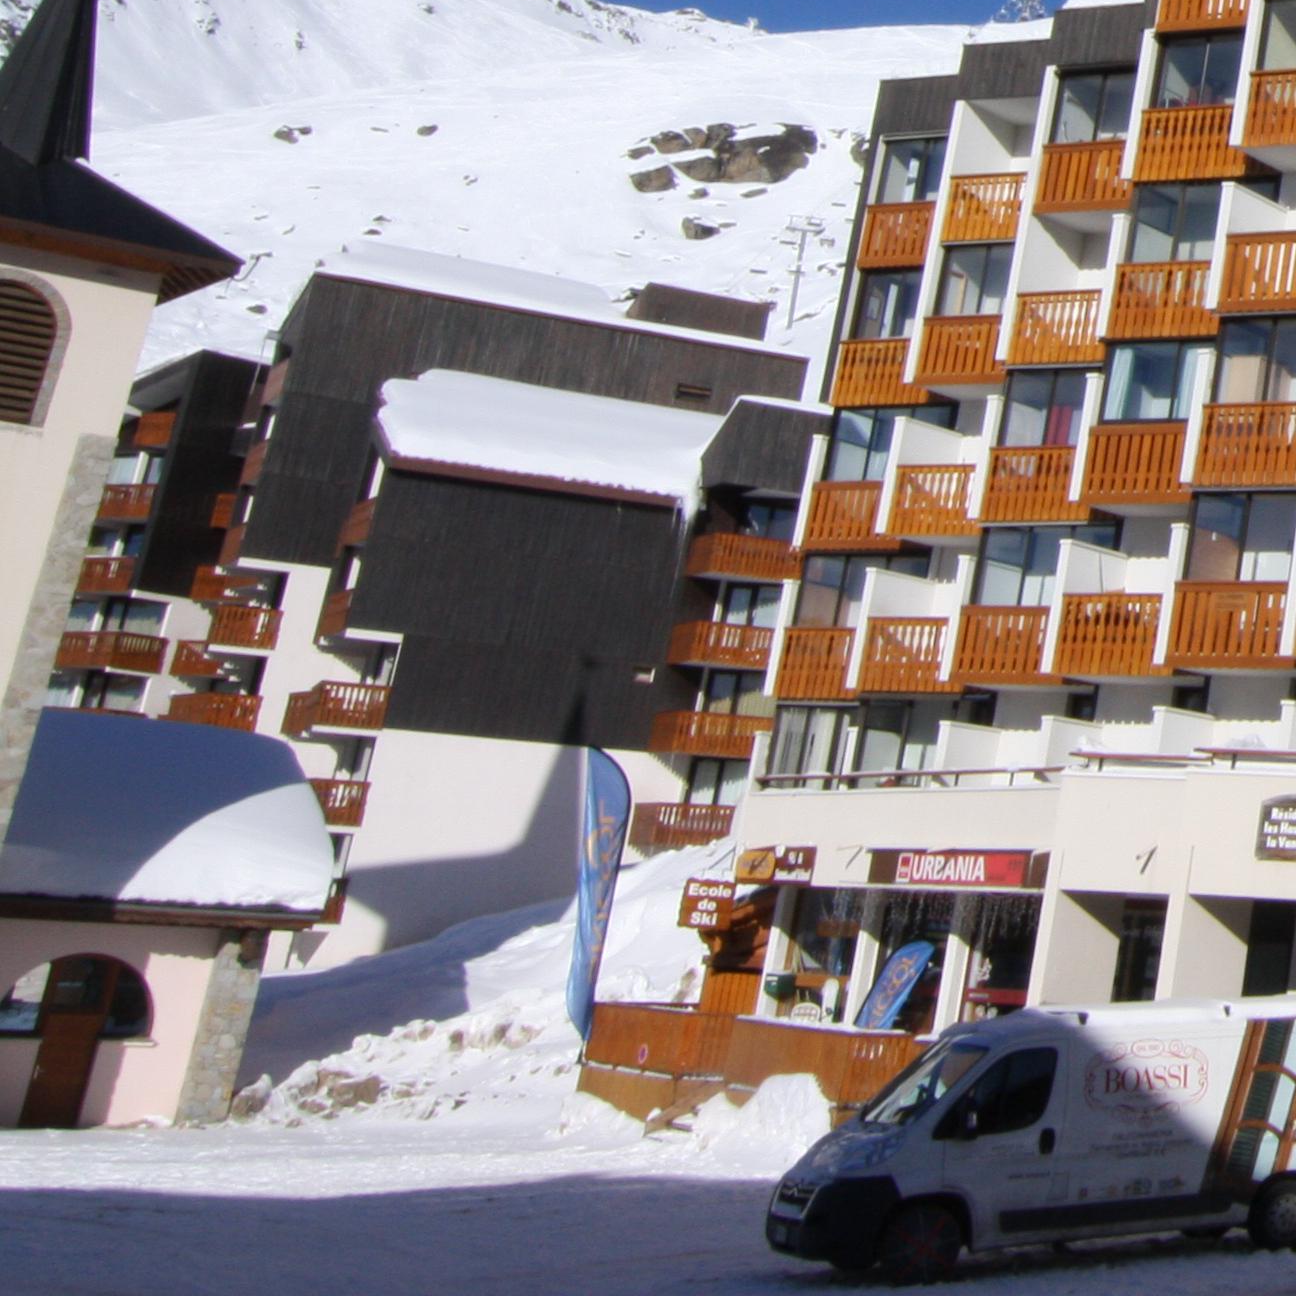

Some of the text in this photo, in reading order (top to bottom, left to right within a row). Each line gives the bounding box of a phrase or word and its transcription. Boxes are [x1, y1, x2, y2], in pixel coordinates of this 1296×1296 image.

[1263, 821, 1278, 834] les
[1266, 836, 1277, 848] la
[912, 855, 985, 881] URBANIA
[688, 882, 732, 898] Ecole
[697, 899, 717, 911] de
[689, 911, 718, 925] Ski
[1104, 1063, 1189, 1094] BOASSI
